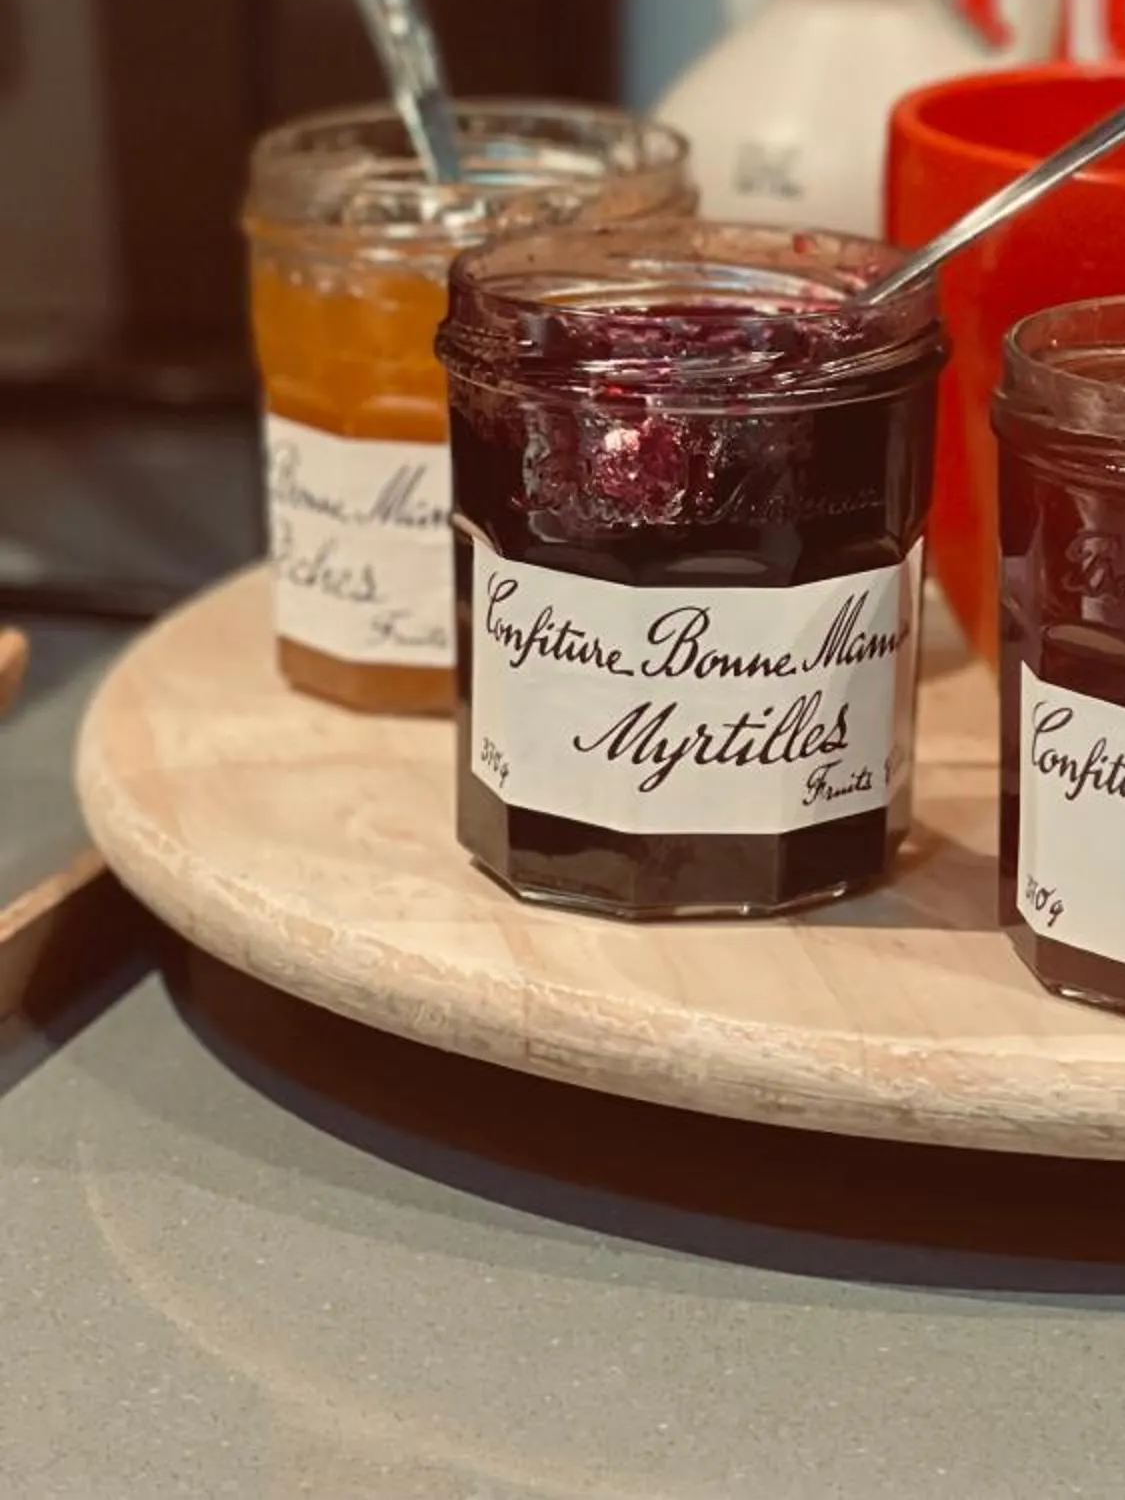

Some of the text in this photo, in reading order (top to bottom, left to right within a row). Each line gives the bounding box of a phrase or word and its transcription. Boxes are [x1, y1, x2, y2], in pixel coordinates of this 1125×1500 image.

[487, 572, 634, 676] Confiture
[642, 606, 798, 679] Bonne
[573, 691, 849, 793] Myrtilles
[802, 760, 872, 805] Fruits
